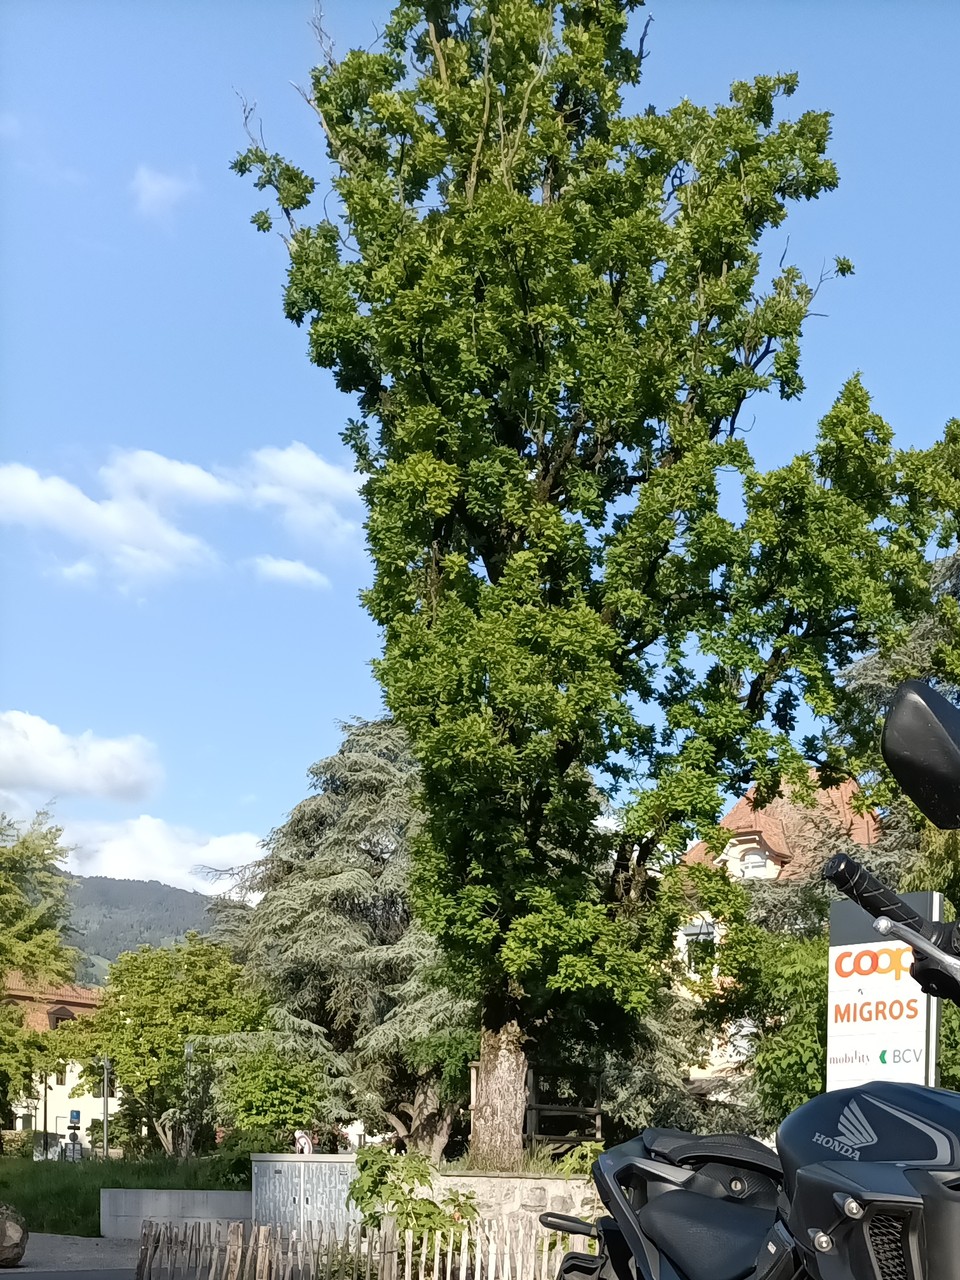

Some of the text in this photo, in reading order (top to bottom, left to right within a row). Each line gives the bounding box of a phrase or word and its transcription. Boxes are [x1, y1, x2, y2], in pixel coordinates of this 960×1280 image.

[835, 946, 914, 981] coop
[834, 998, 919, 1023] MIGROS
[893, 1048, 923, 1064] BCV
[812, 1132, 861, 1161] HONDA
